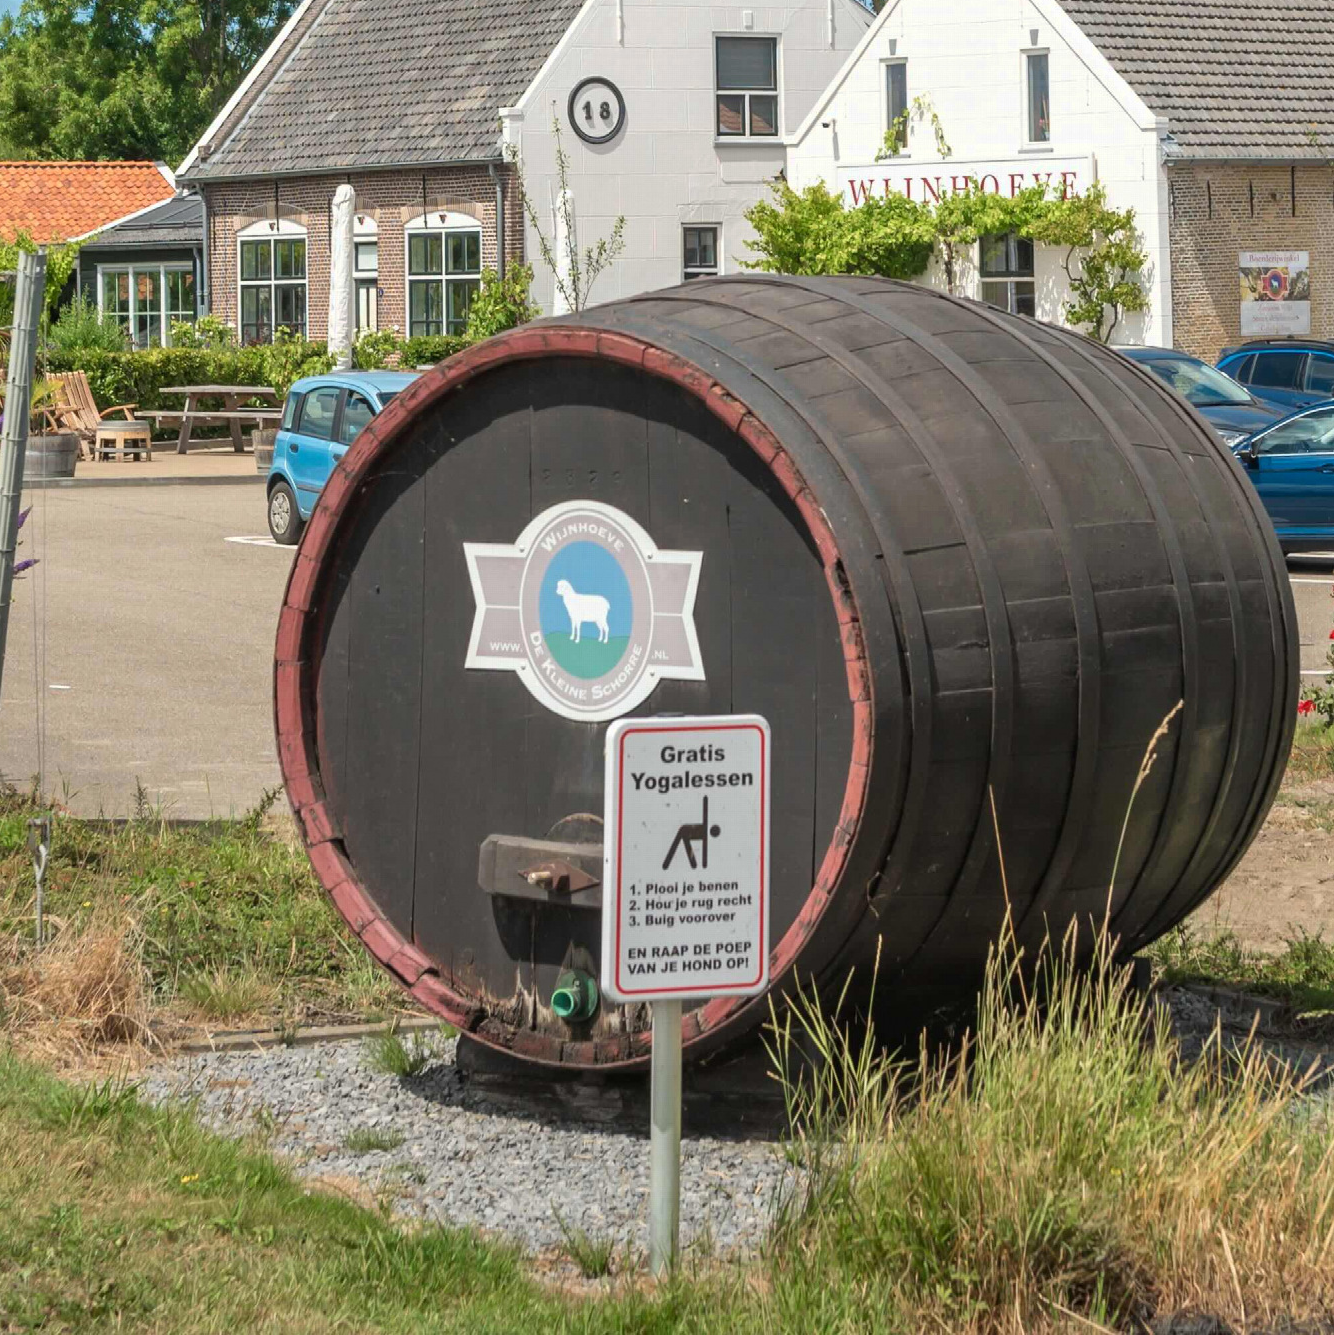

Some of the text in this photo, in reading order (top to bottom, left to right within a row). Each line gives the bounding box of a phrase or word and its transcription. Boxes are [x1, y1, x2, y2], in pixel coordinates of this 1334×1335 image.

[582, 101, 611, 120] 18
[660, 744, 726, 763] Gratis
[631, 770, 754, 794] Yogalessen
[629, 881, 739, 896] 1. Plooi je benen
[629, 893, 752, 912] 2. Hou je rug recht
[628, 911, 736, 927] 3. Buig voorover
[627, 941, 752, 960] EN RAAP DE POEP
[627, 957, 749, 975] VAN JE HOND OP!
